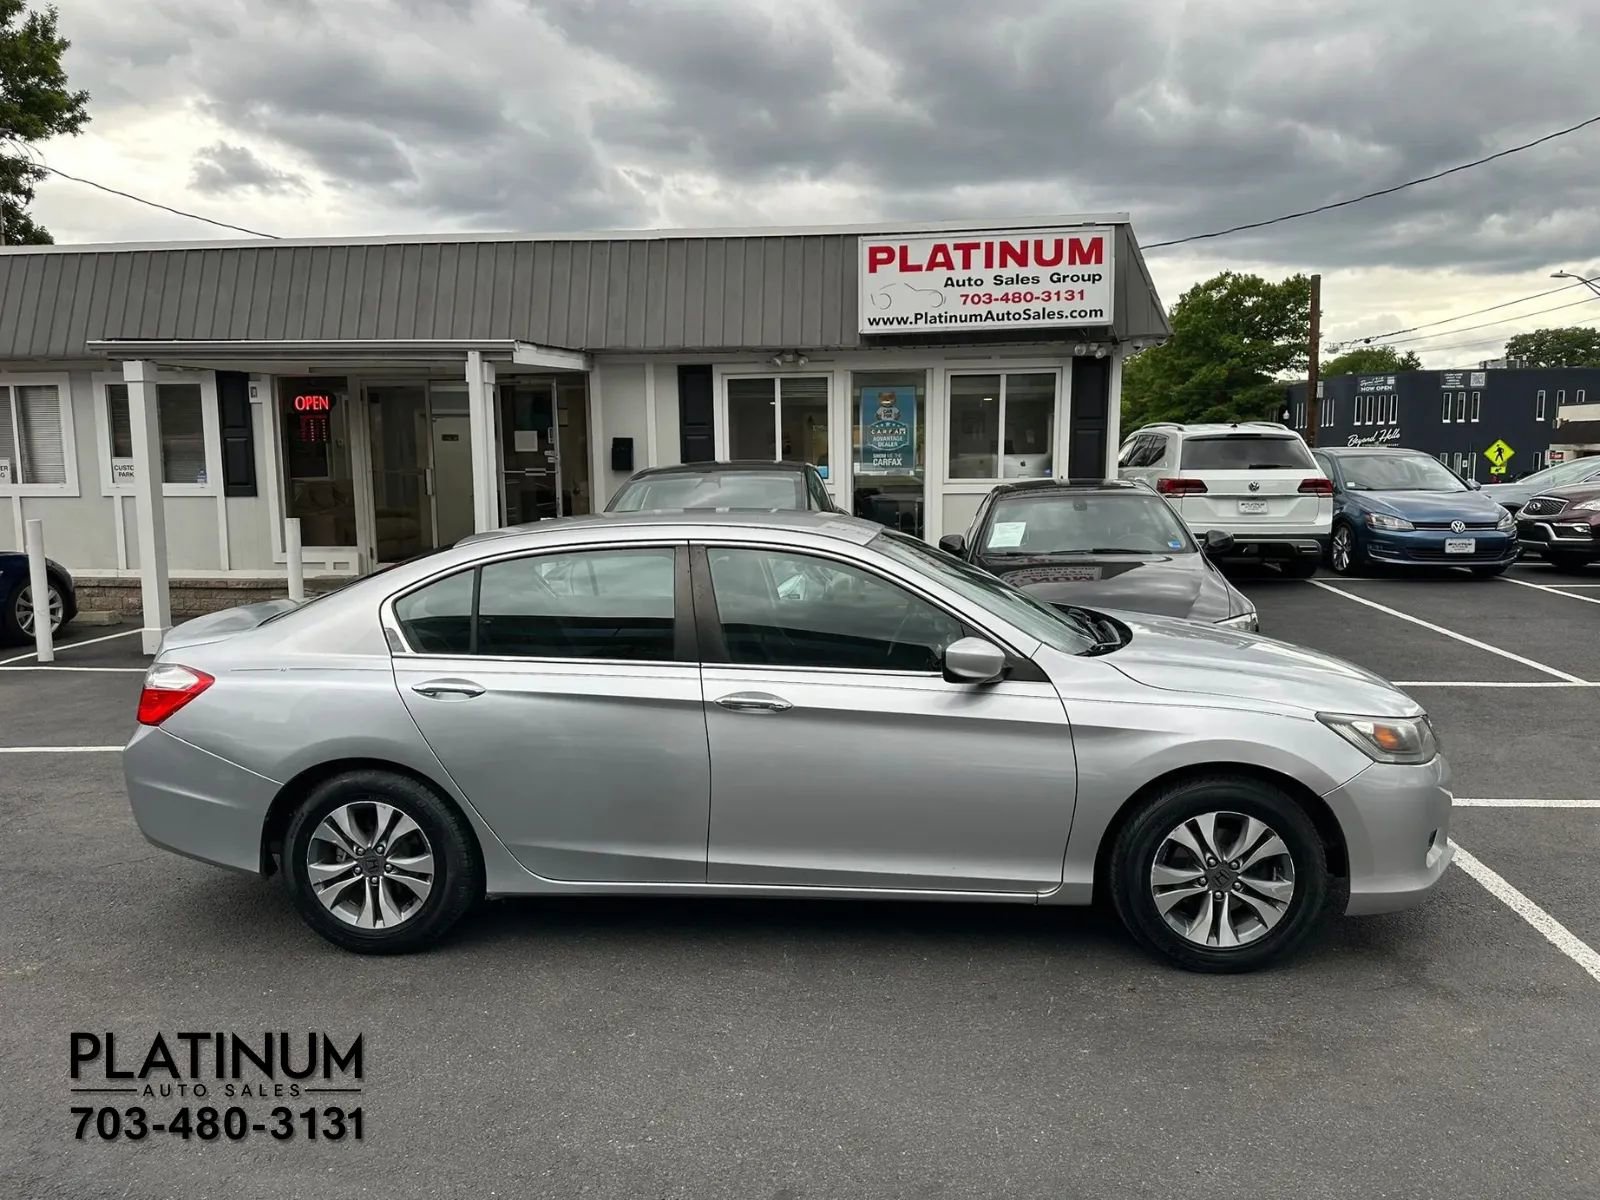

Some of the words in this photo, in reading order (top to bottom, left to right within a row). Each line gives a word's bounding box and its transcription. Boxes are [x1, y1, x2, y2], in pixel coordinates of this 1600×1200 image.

[868, 237, 1103, 274] PLATINUM
[943, 275, 984, 288] Auto
[992, 274, 1040, 287] Sales
[1049, 272, 1103, 284] Group
[959, 289, 1085, 306] 703-480-3131
[867, 306, 1104, 327] www.PlatinumAutoSales.com
[294, 395, 329, 410] OPEN
[1347, 431, 1379, 447] Beyond
[1379, 428, 1401, 442] Hello
[873, 458, 903, 466] CARFAX
